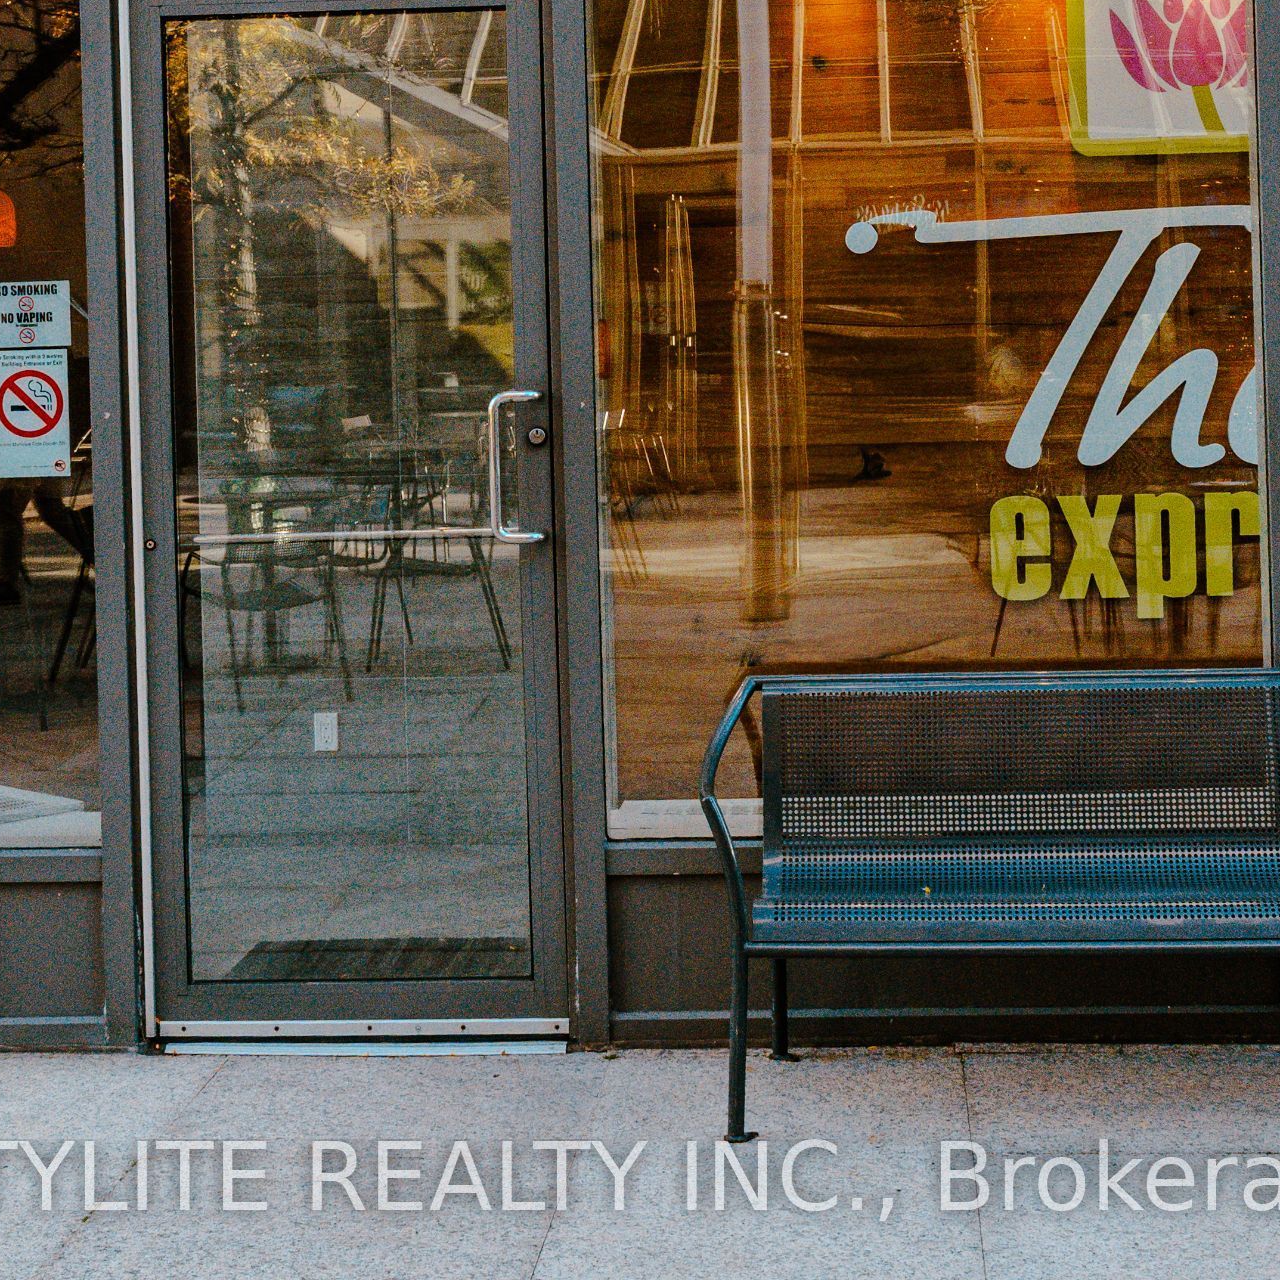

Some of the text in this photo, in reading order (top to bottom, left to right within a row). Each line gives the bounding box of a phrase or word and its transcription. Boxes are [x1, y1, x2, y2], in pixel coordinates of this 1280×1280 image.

[10, 284, 58, 296] SMOKING
[1, 312, 53, 323] NO VAPING
